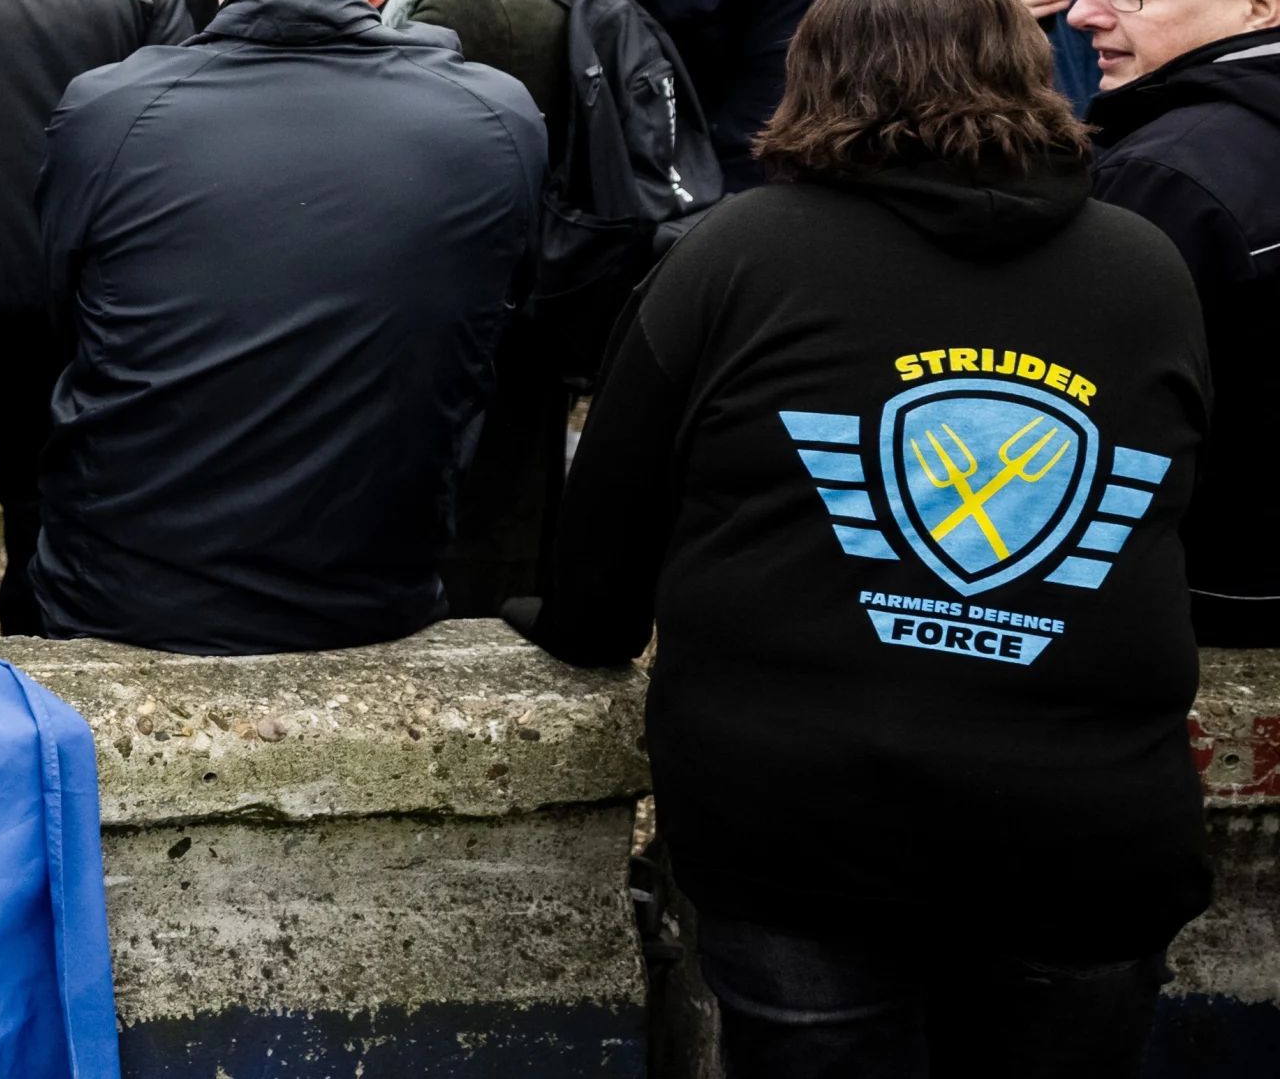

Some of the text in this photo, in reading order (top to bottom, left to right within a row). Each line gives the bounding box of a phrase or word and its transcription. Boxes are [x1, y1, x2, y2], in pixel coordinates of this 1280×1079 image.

[894, 347, 1098, 407] STRIJDER
[860, 591, 1065, 634] FARMERS DEFENCE
[890, 617, 1024, 660] FORCE
